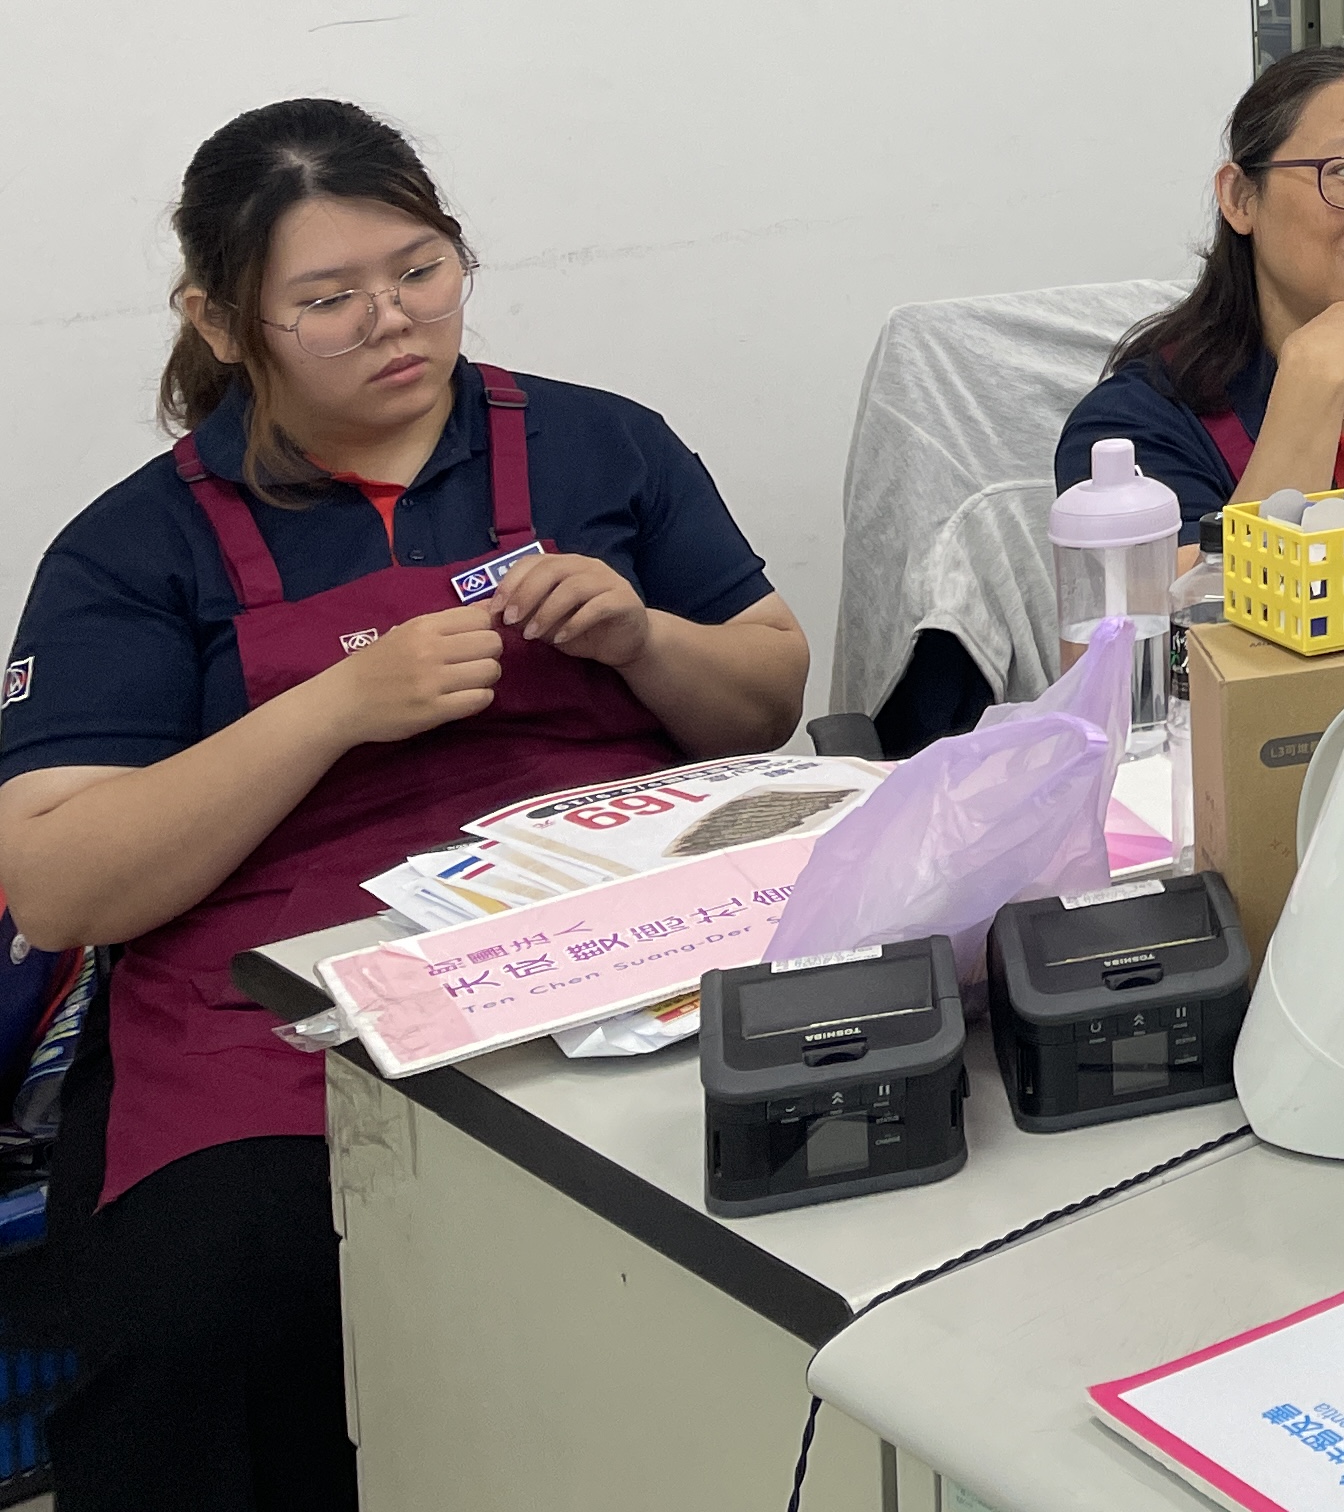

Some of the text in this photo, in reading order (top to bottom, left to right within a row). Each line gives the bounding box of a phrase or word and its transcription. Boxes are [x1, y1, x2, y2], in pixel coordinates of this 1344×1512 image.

[562, 786, 711, 832] 169
[461, 923, 752, 1016] Ten Chen Suang-Der
[1103, 953, 1156, 967] TOSHIBA
[804, 1027, 863, 1043] TOSHIBA
